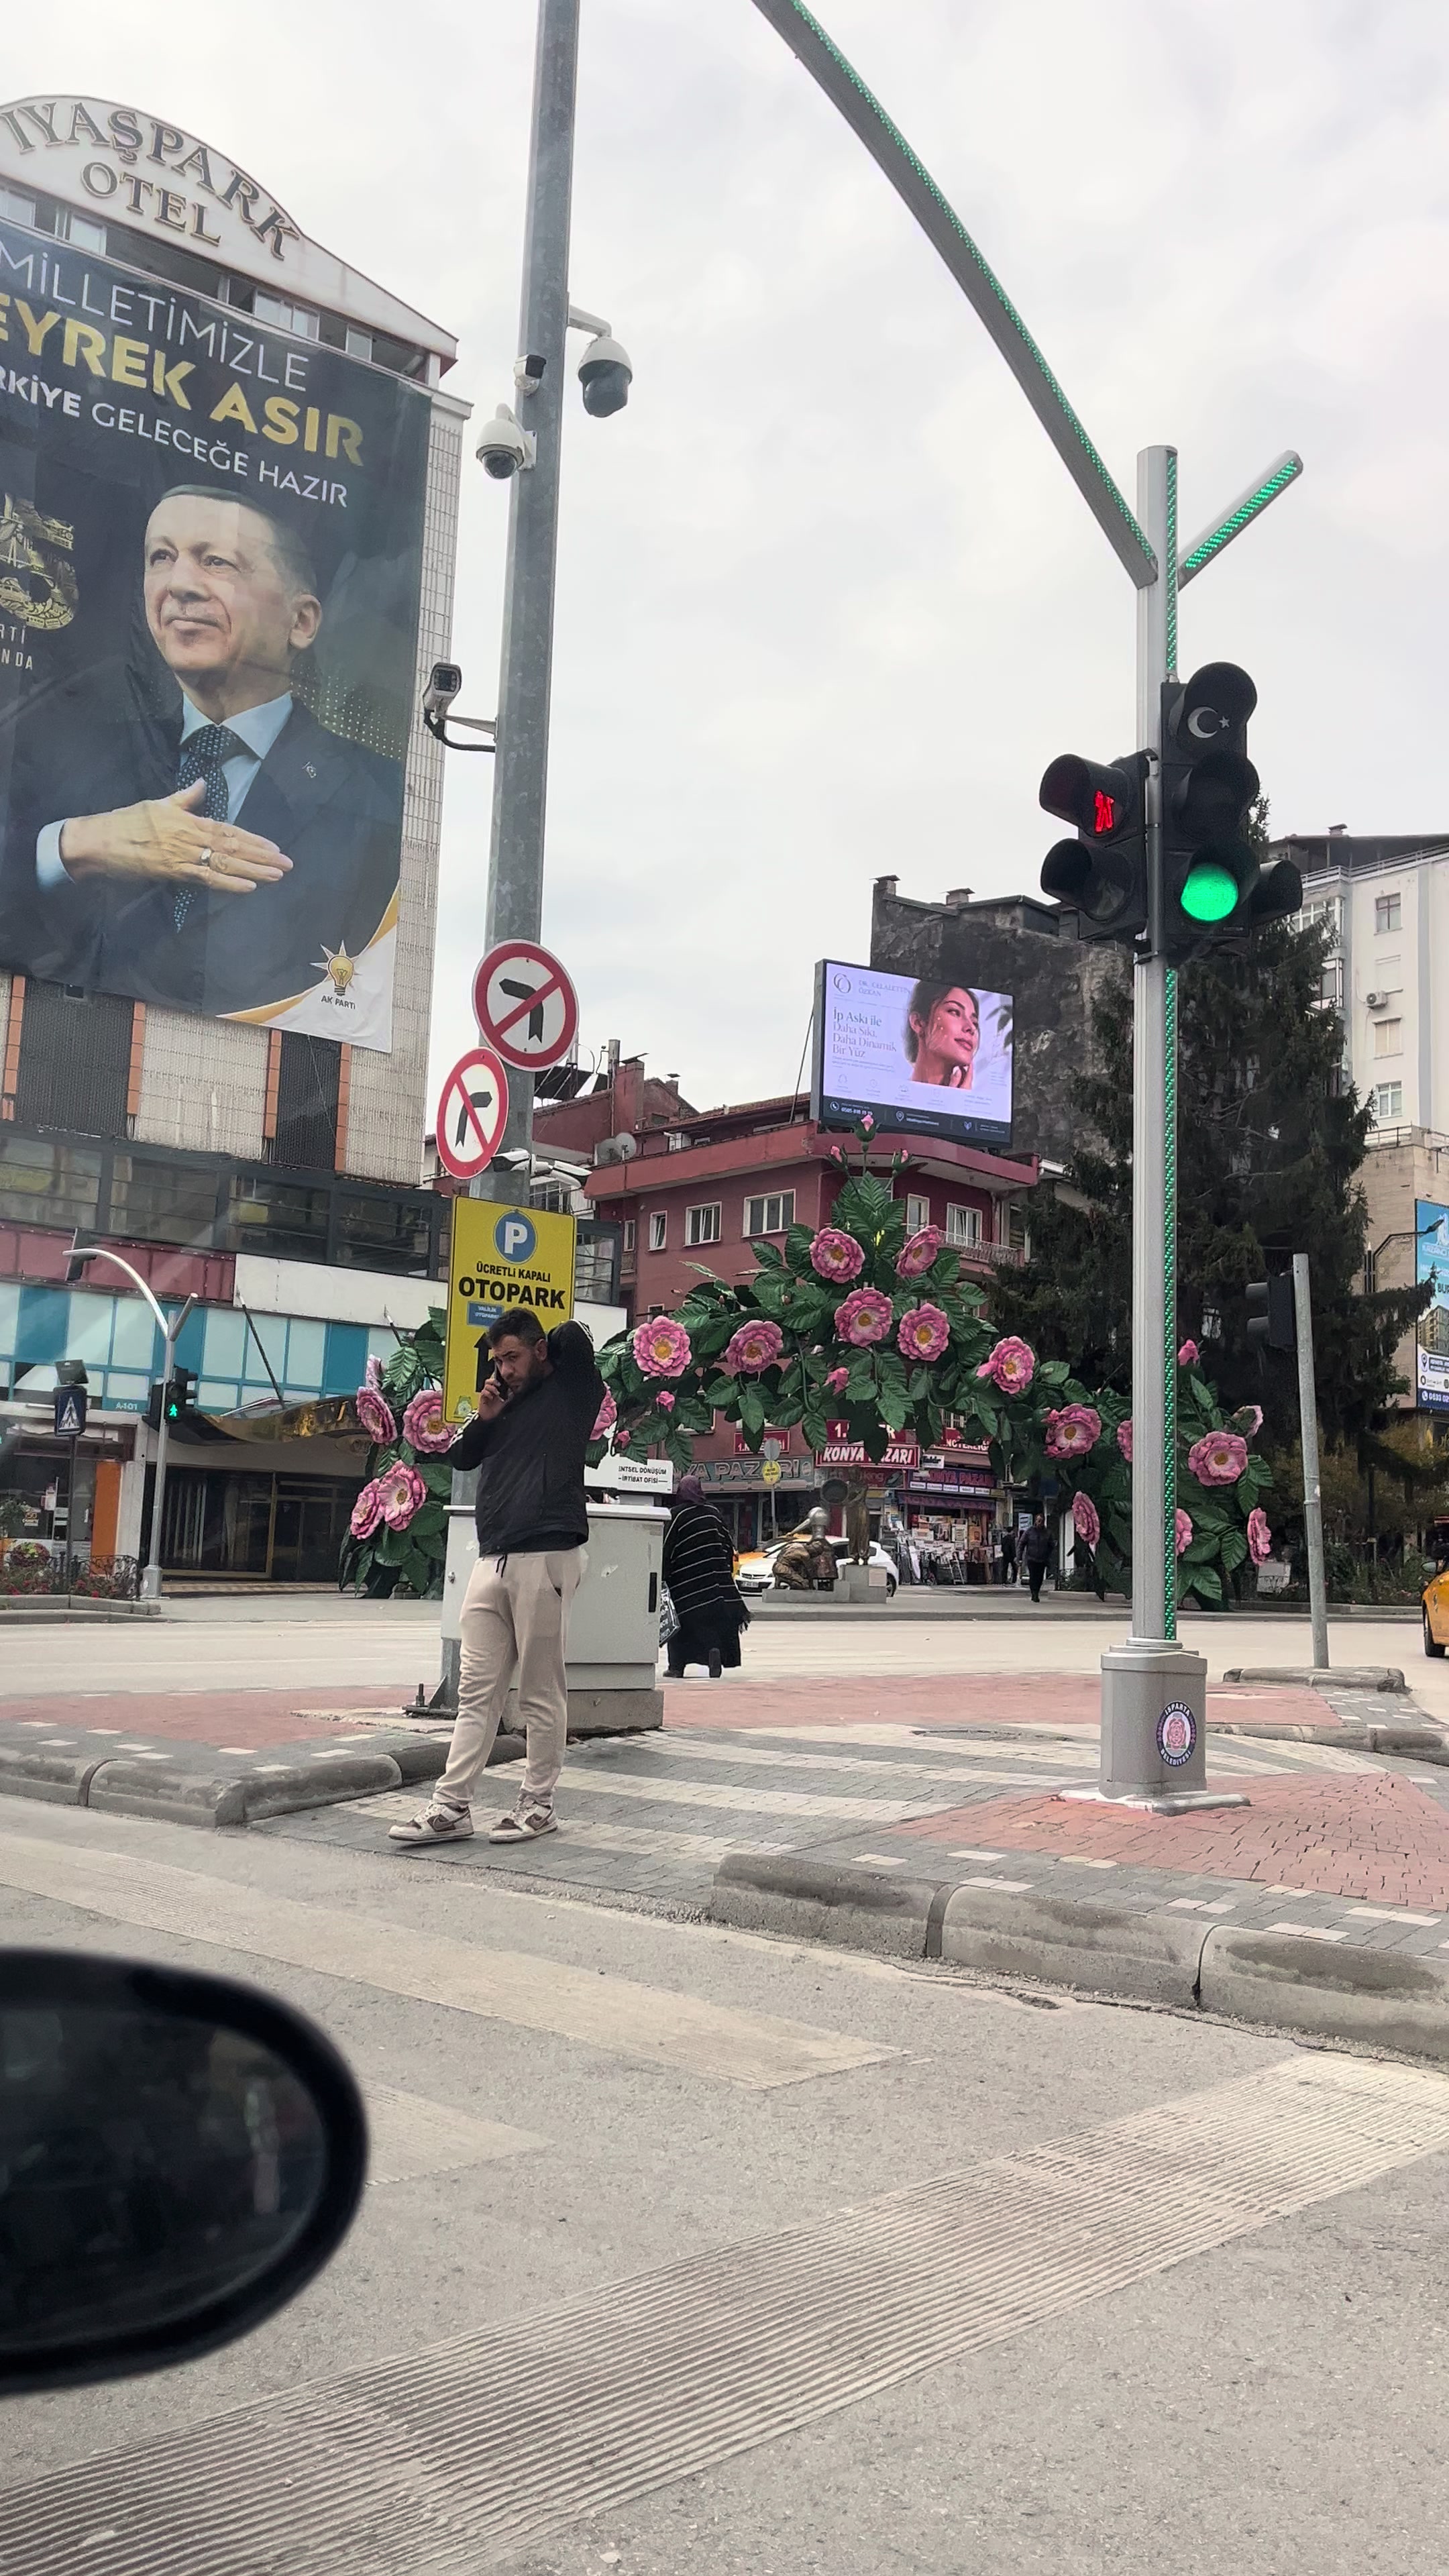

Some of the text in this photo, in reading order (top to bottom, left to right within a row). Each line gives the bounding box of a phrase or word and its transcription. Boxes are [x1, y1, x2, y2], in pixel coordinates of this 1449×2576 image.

[80, 161, 221, 247] OTEL
[0, 240, 309, 392] MİLLETİMİZLE
[209, 382, 364, 466] ASIR
[92, 402, 249, 476] GELECEĞE
[259, 460, 347, 508] HAZIR
[321, 996, 333, 1004] AK
[833, 1006, 882, 1026] İp Askı ile
[833, 1022, 857, 1034] Daha
[833, 1033, 896, 1052] Daha Dinamik
[833, 1044, 846, 1055] Bir
[504, 1221, 528, 1254] P
[518, 1269, 551, 1283] KAPALI
[459, 1277, 566, 1309] OTOPARK
[823, 1446, 865, 1462] KONYA
[1165, 1703, 1190, 1716] ISPARTA
